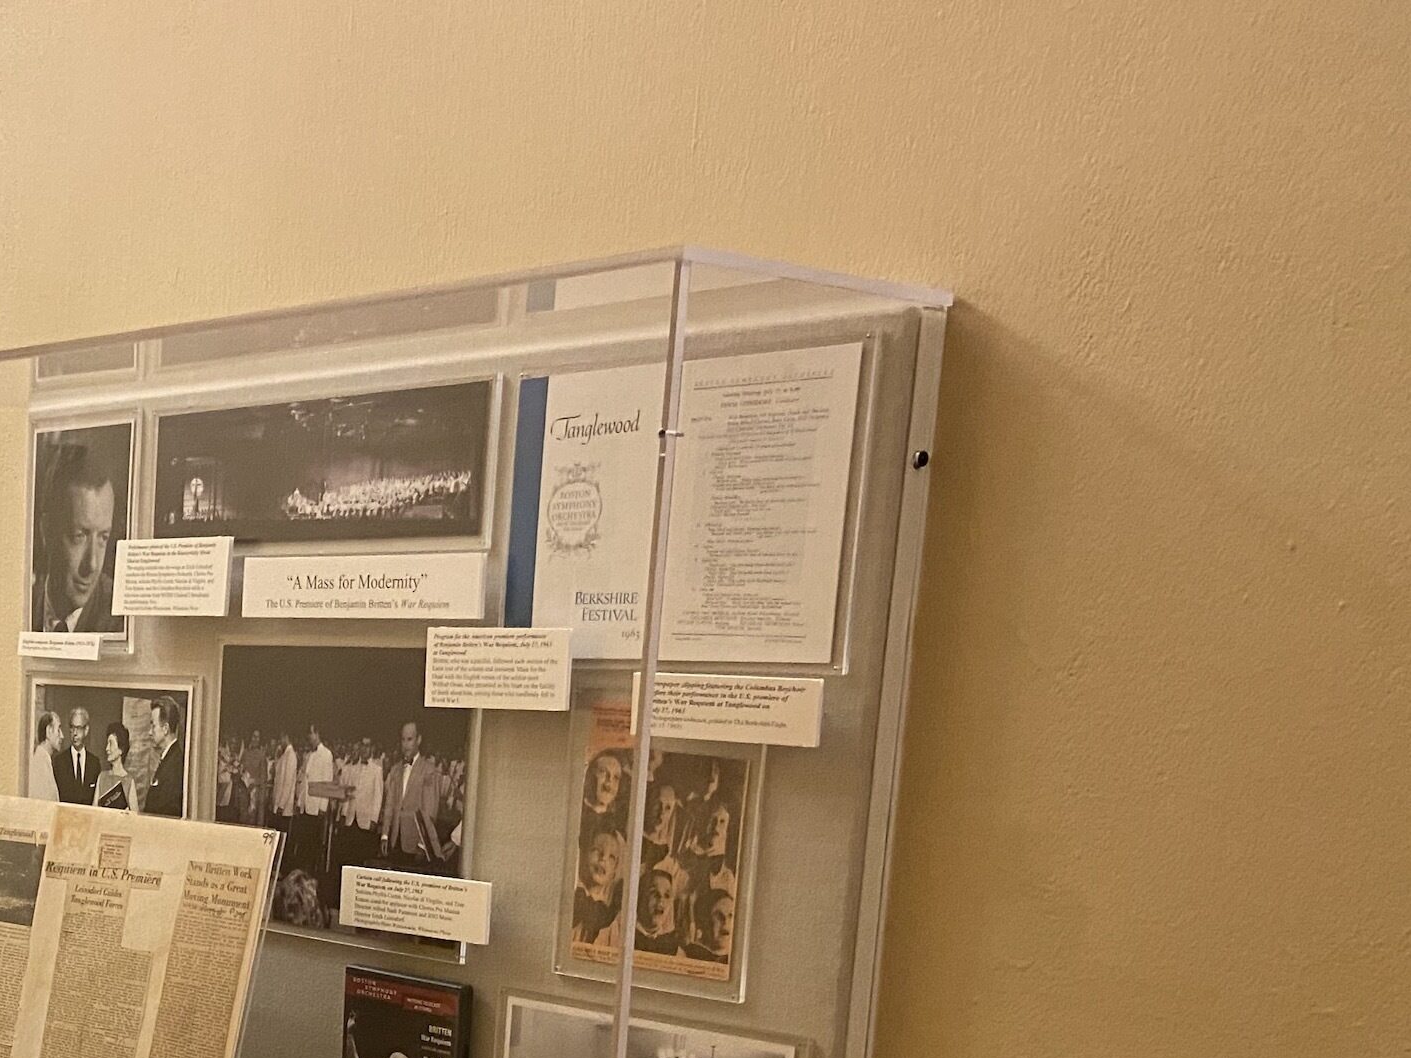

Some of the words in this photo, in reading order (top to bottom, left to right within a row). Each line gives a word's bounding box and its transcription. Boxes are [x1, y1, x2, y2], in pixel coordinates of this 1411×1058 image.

[550, 409, 641, 445] Tanglewood
[287, 576, 302, 590] “A
[306, 575, 334, 590] Mass
[339, 575, 355, 589] for
[358, 573, 427, 592] Modernity”
[266, 599, 277, 608] The
[279, 599, 292, 608] U.S.
[325, 599, 333, 609] of
[335, 599, 366, 610] Benjamin
[401, 599, 416, 609] War
[418, 600, 449, 610] Requiem
[575, 592, 638, 605] BERKSHIRE
[582, 609, 637, 621] FESTIVAL
[46, 861, 86, 876] Requiem
[89, 866, 98, 877] in
[101, 868, 118, 879] U.S.
[189, 861, 202, 872] New
[206, 863, 230, 876] Britten
[233, 867, 252, 879] Work
[186, 875, 208, 887] Stands
[227, 881, 247, 894] Great
[70, 895, 104, 907] Tanglewood
[105, 900, 122, 909] Forces
[184, 889, 208, 904] Moving
[212, 894, 250, 909] Monument
[353, 977, 376, 985] BOSTON
[356, 989, 391, 1000] ORCHESTRA
[365, 985, 397, 995] SYMPHONY
[429, 1025, 452, 1037] BRITTEN
[431, 1036, 451, 1046] Requiem
